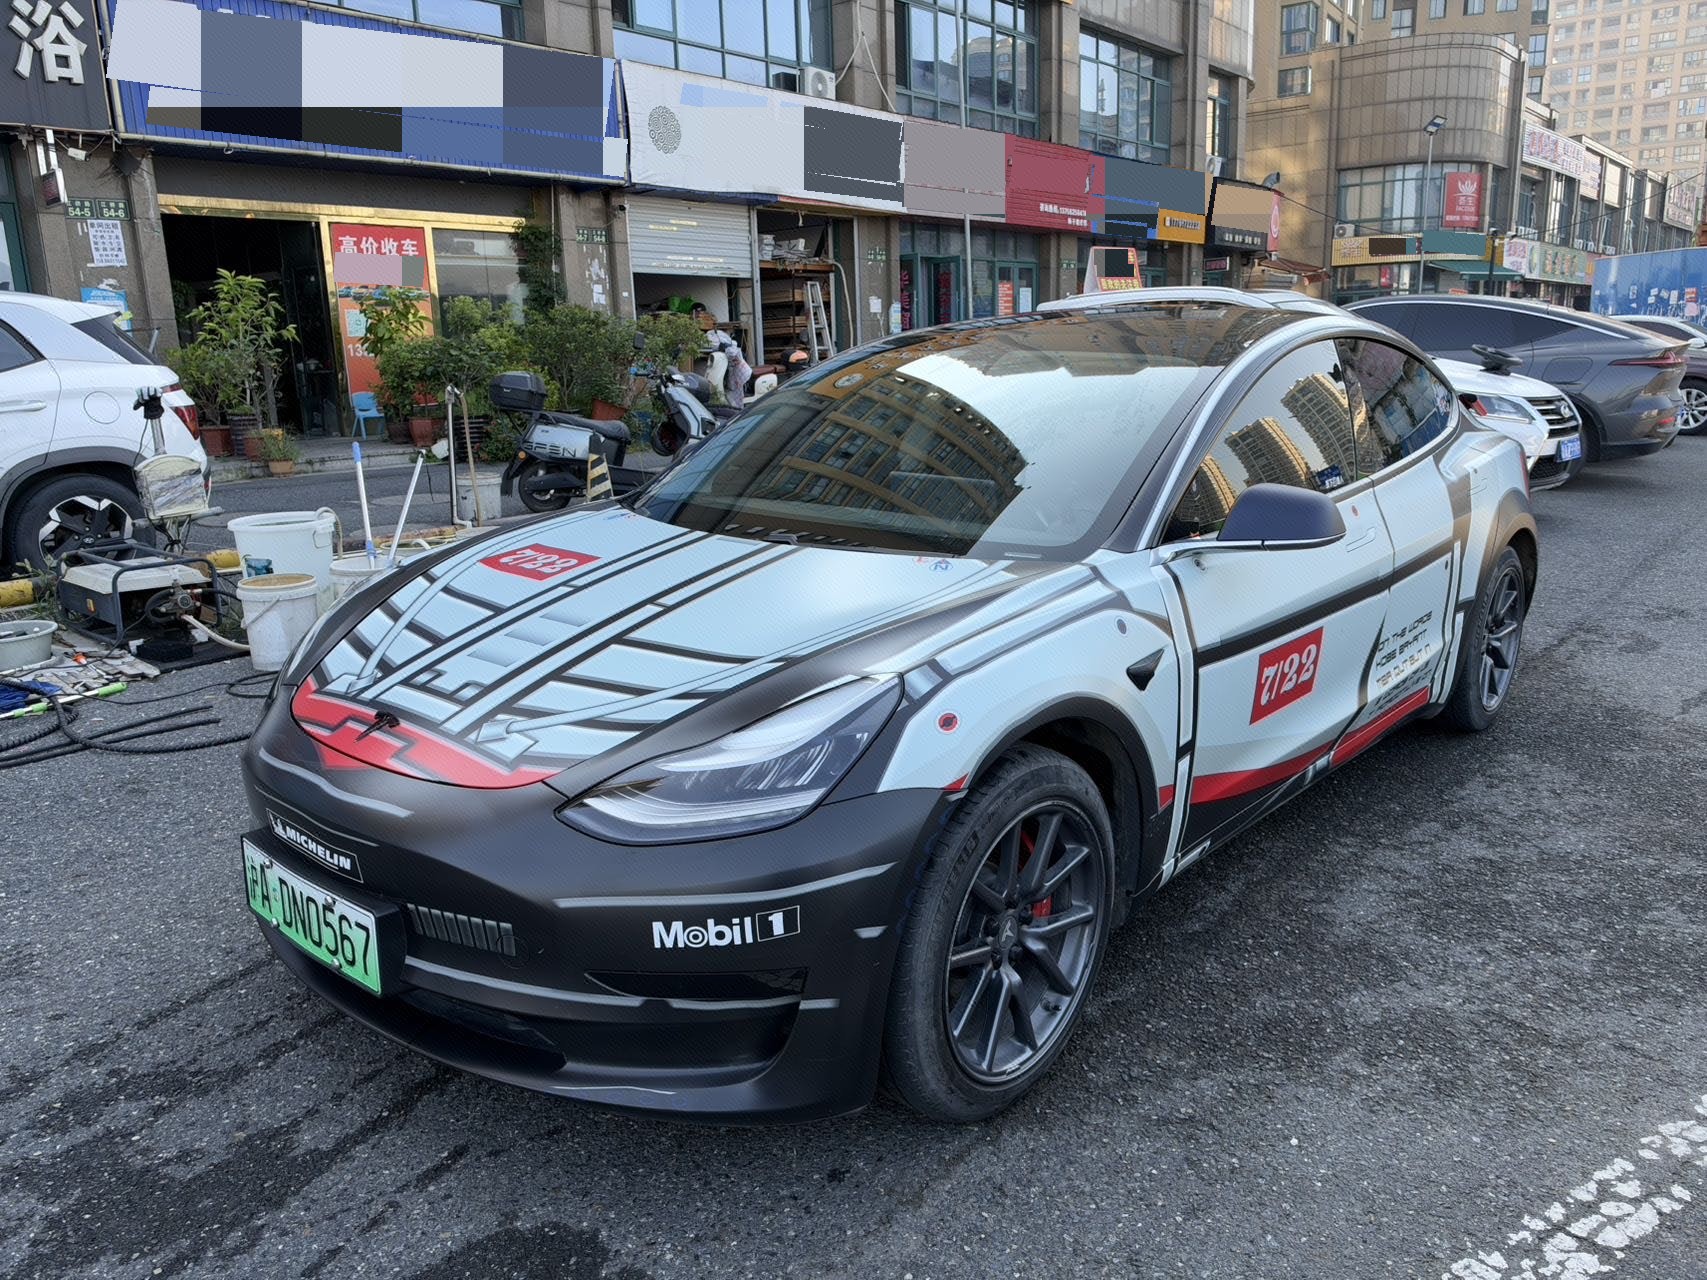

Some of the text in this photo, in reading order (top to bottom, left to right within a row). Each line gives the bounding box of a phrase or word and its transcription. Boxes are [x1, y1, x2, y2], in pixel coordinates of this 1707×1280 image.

[9, 0, 87, 84] 浴
[68, 207, 91, 217] 54-5
[103, 208, 125, 218] 54-6
[338, 235, 420, 257] 高价收车
[1261, 644, 1317, 706] 7/22
[286, 825, 351, 871] MICHELIN
[652, 912, 785, 948] Mobil 1
